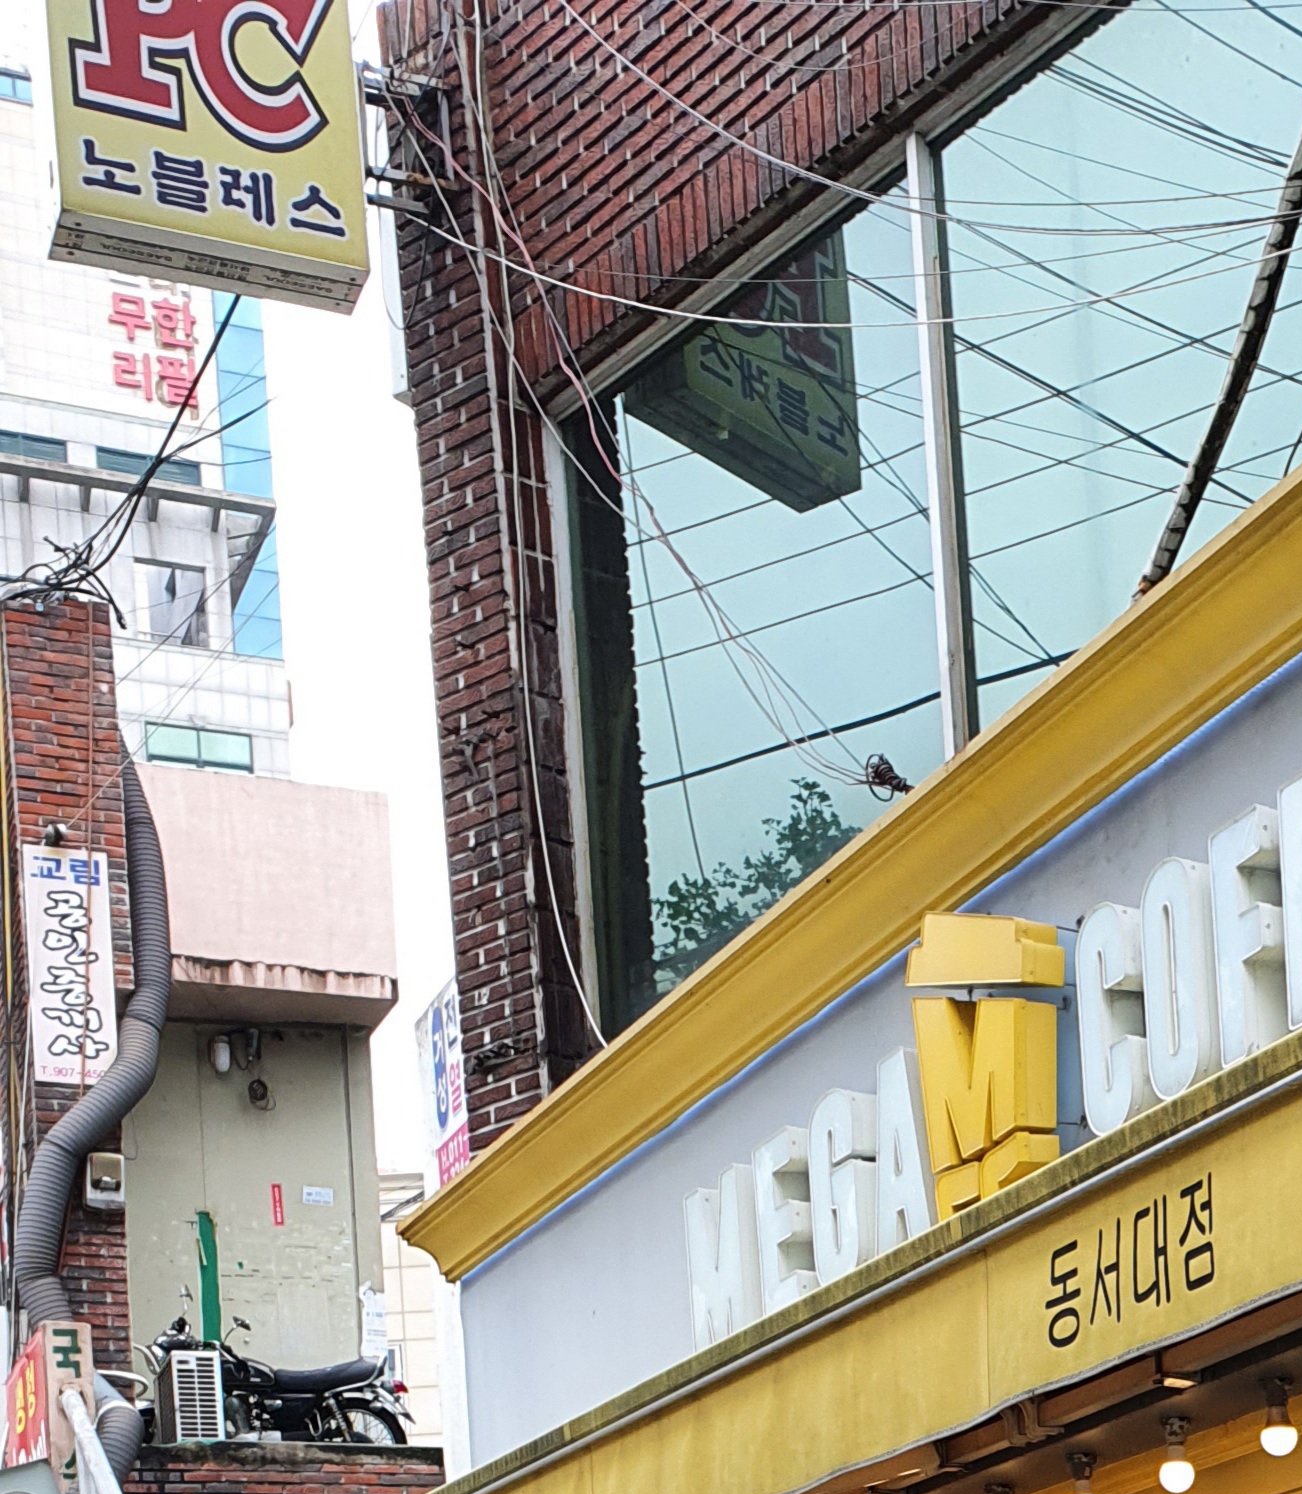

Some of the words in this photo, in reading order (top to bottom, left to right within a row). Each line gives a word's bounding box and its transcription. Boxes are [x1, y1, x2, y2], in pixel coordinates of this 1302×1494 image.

[68, 0, 330, 153] PC
[82, 137, 348, 239] 노블레스
[108, 291, 197, 350] 무한
[111, 350, 199, 408] 리필
[683, 1046, 938, 1352] MEGA
[1043, 1171, 1217, 1350] 동서대점
